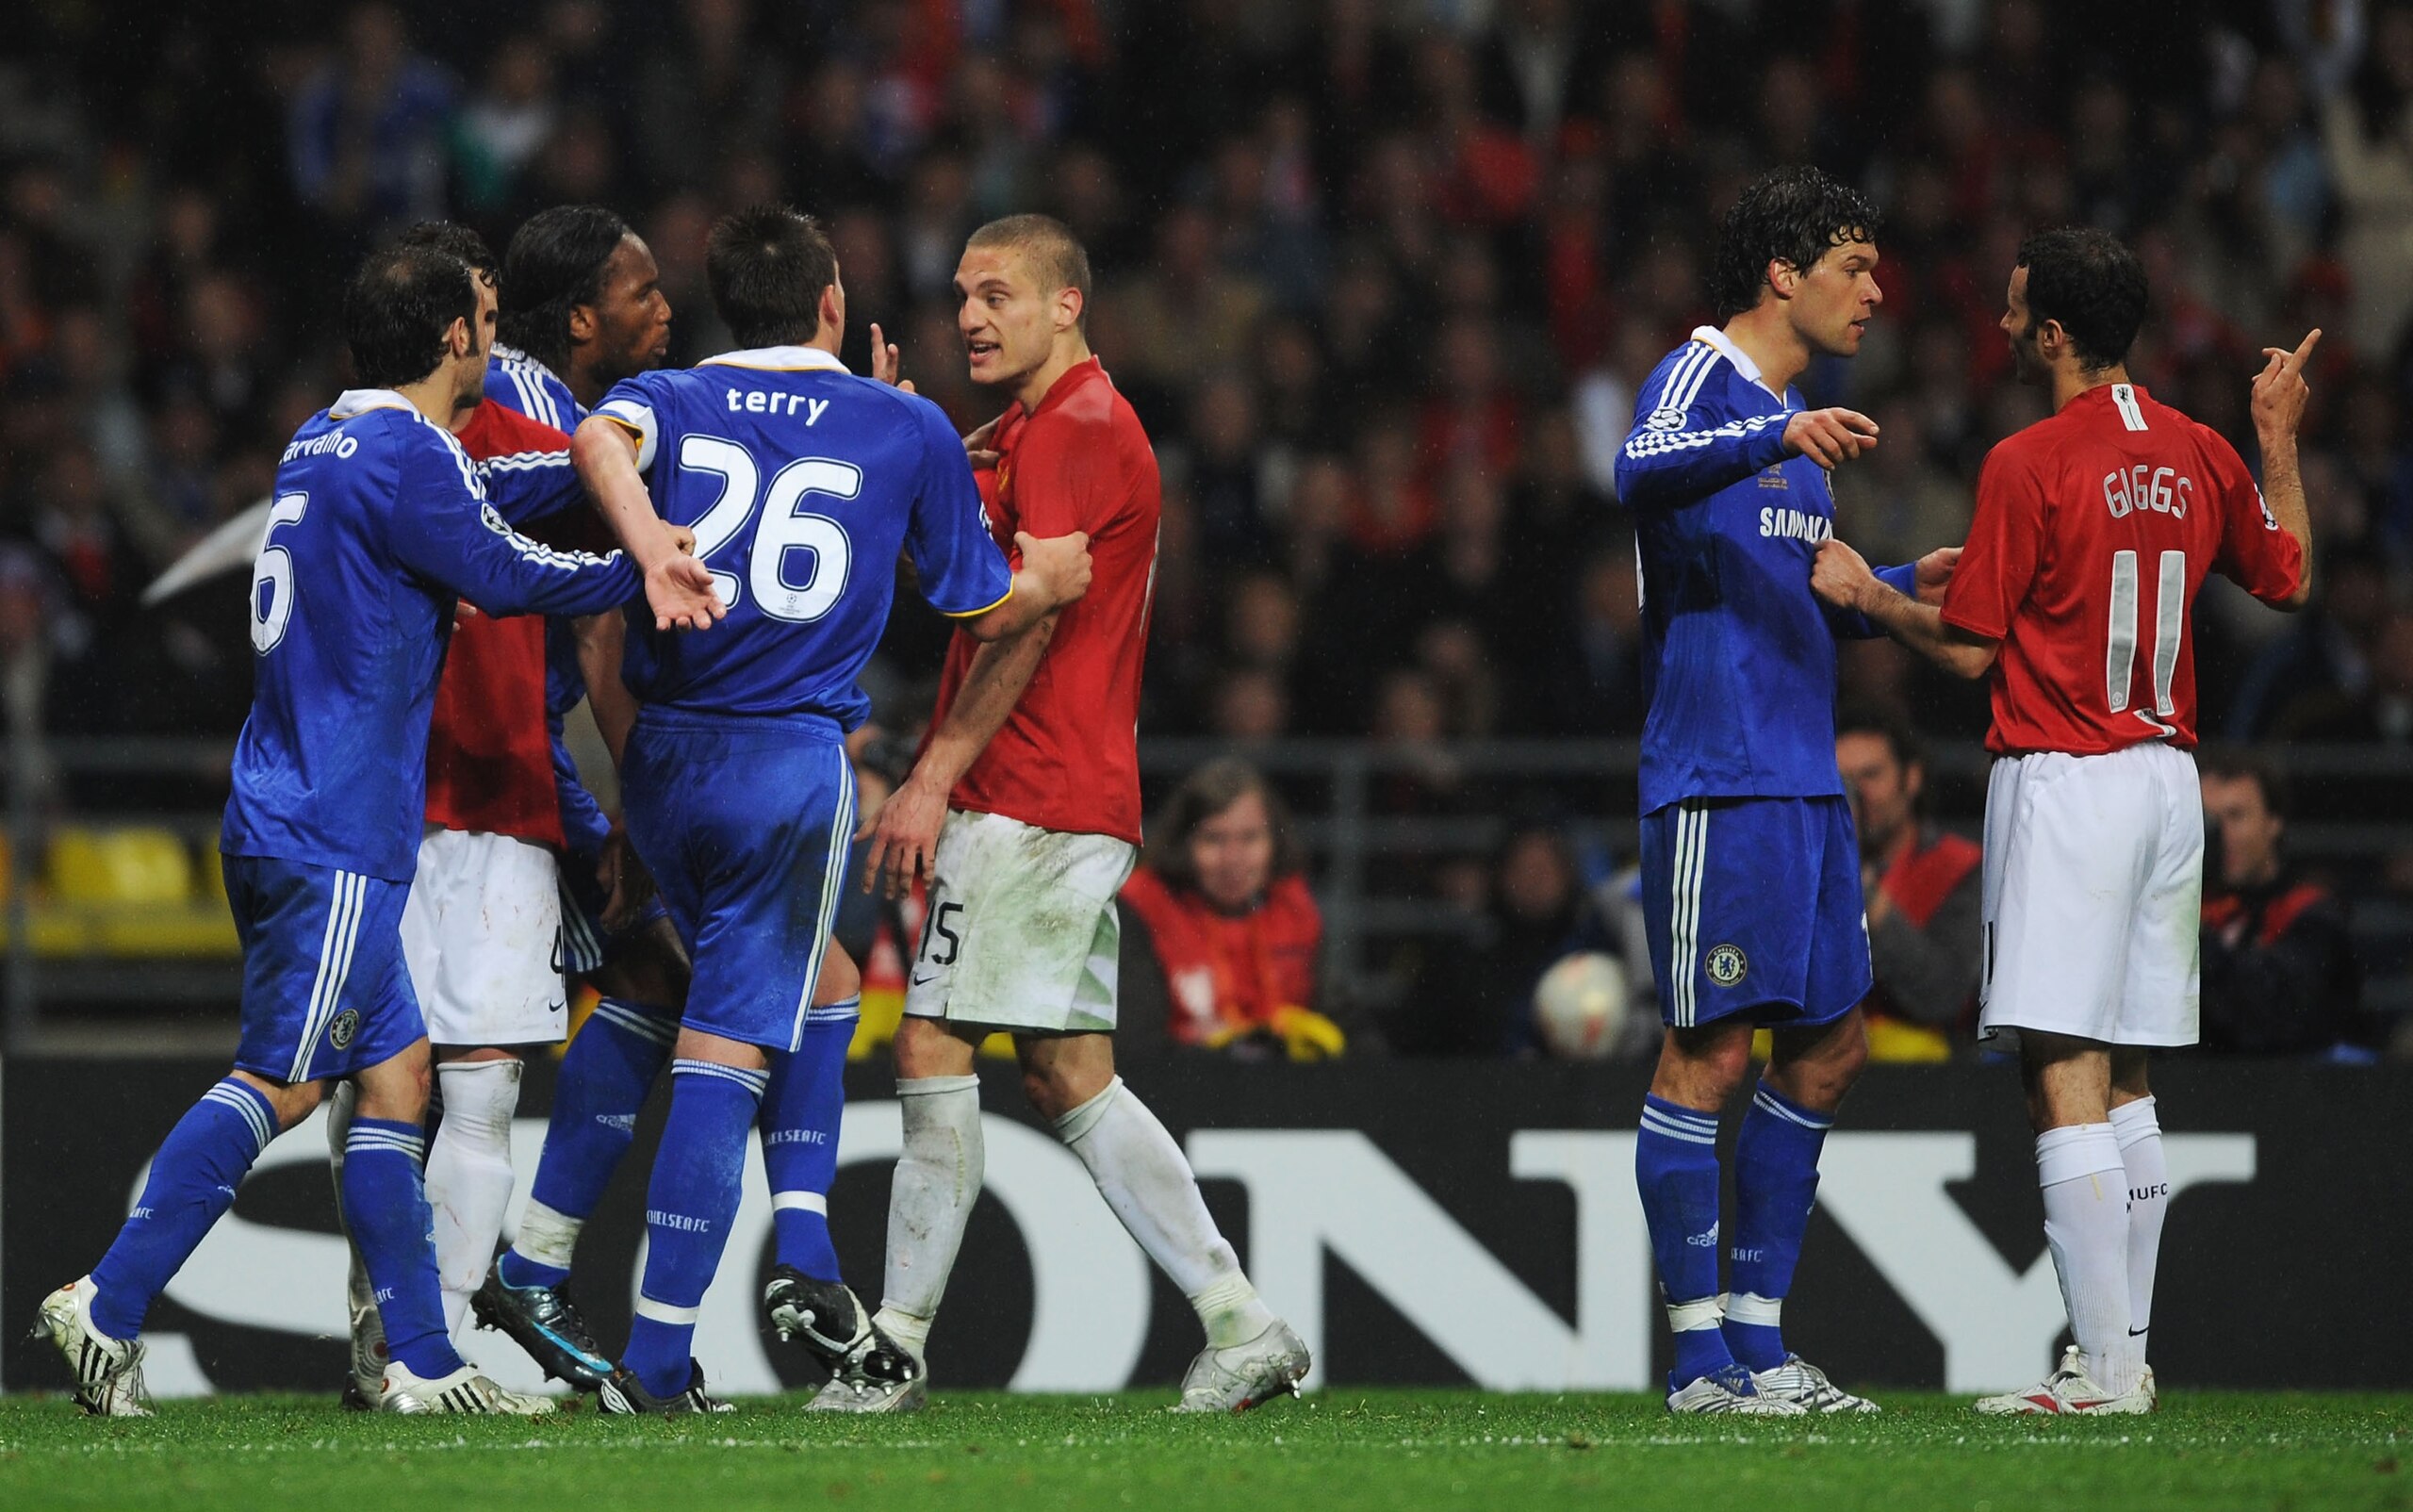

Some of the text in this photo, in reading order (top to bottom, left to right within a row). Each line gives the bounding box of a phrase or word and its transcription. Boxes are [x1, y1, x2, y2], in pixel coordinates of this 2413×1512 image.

[279, 426, 358, 466] arvalho
[726, 387, 829, 426] terry
[679, 434, 863, 623] 26
[2103, 465, 2192, 519] GIGGS
[250, 490, 309, 656] 6
[2106, 550, 2186, 716] 11
[919, 899, 964, 966] 15
[128, 1101, 2256, 1393] SONY
